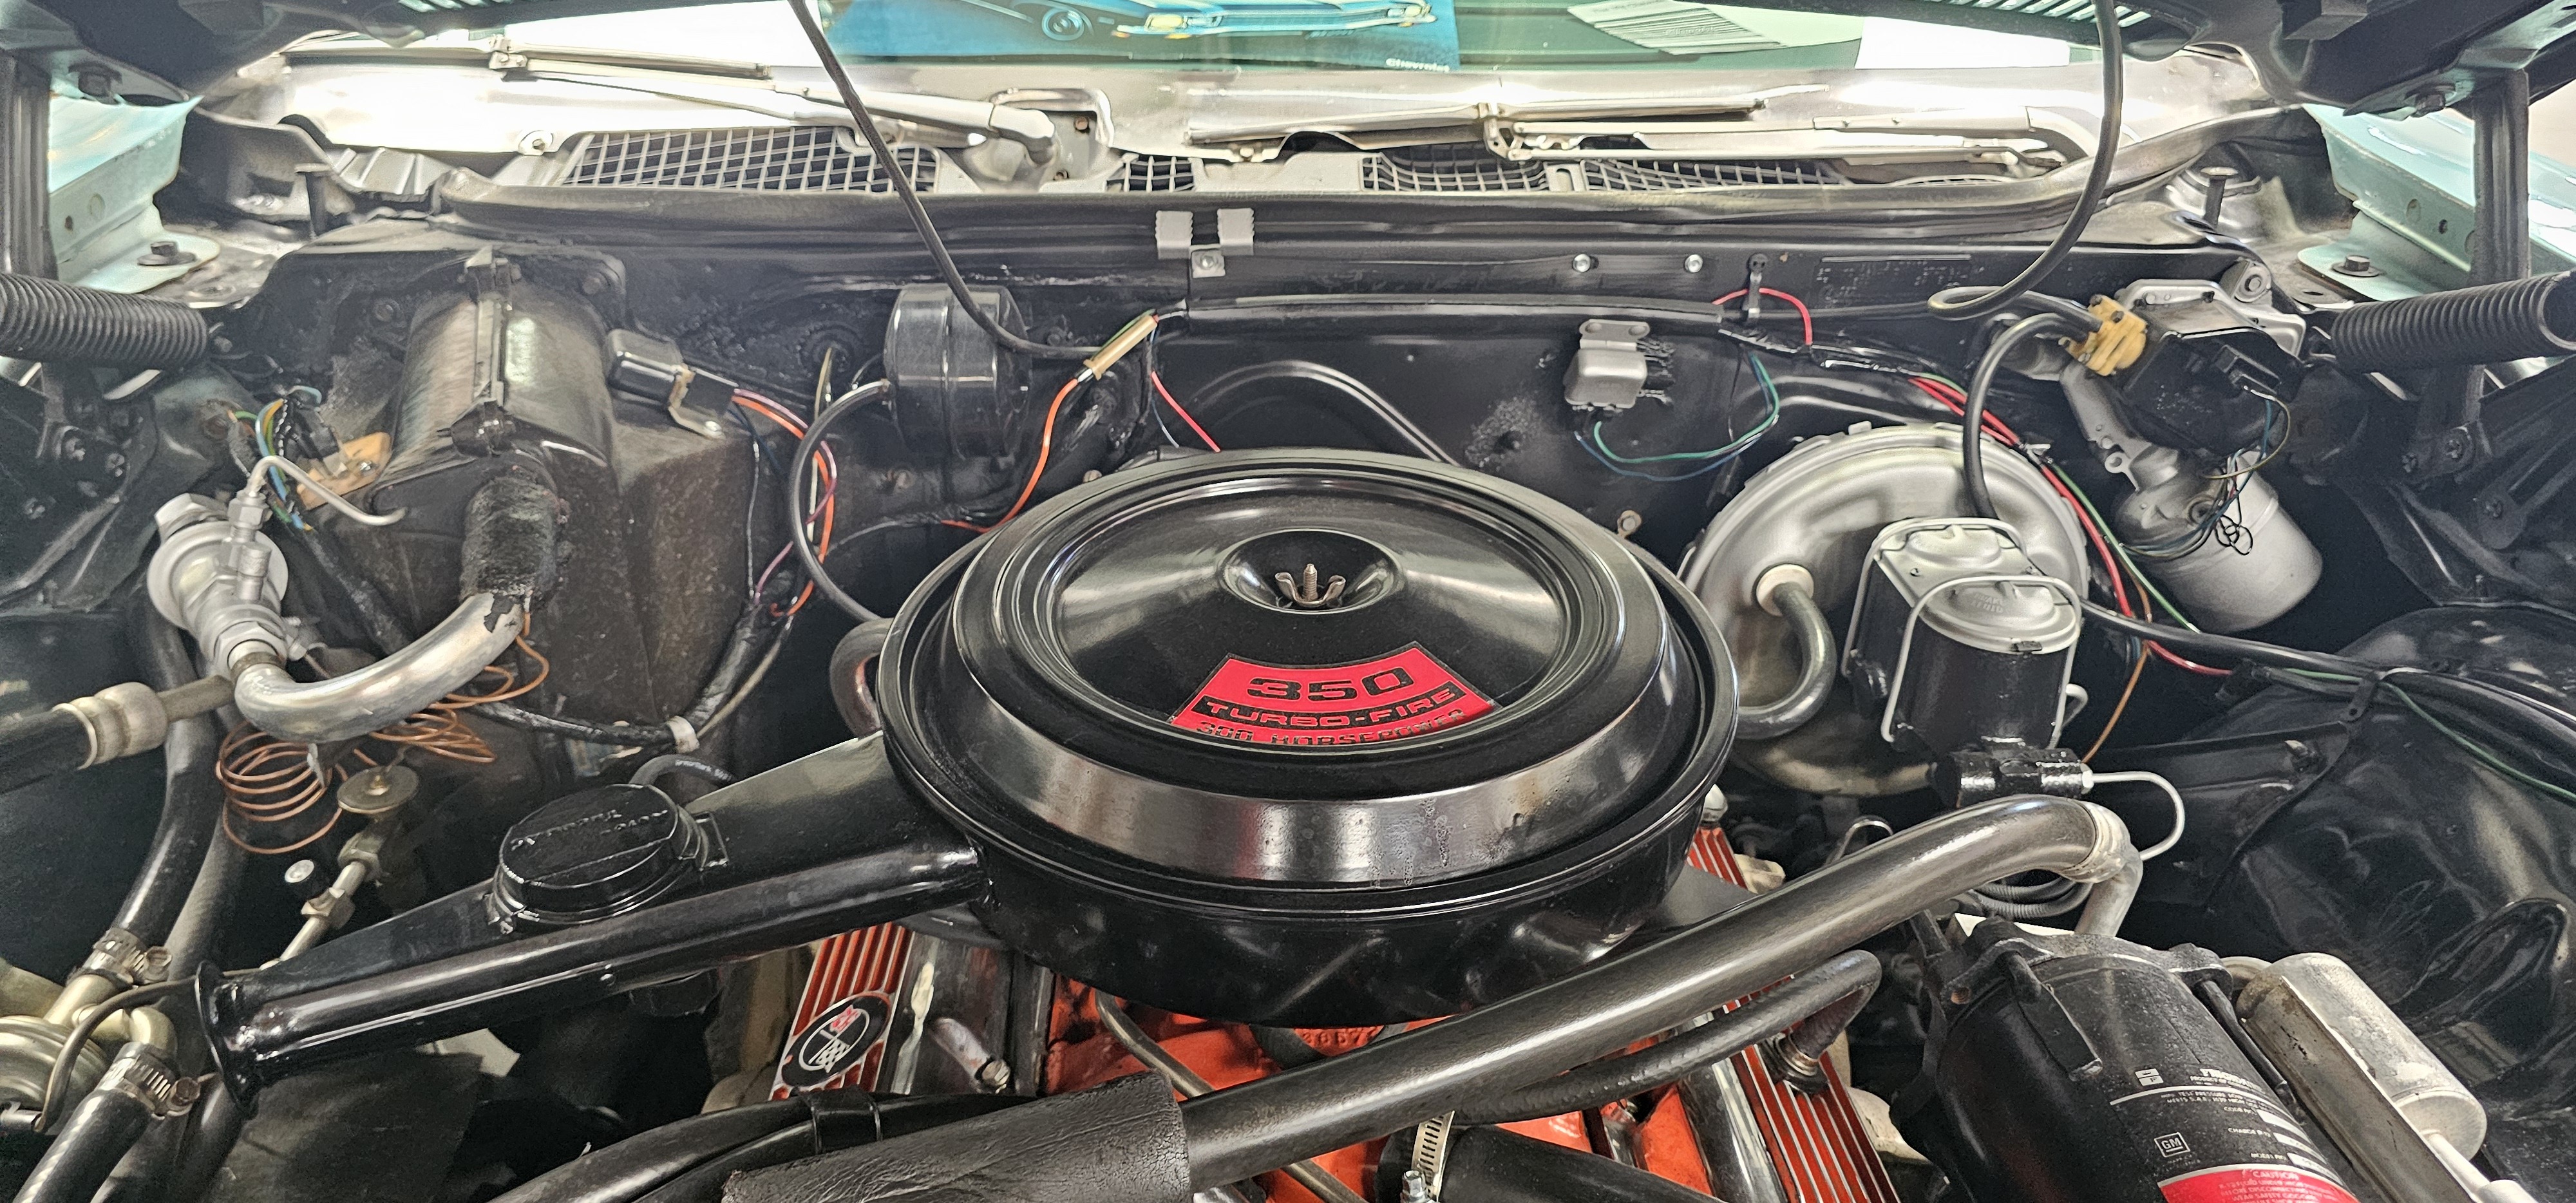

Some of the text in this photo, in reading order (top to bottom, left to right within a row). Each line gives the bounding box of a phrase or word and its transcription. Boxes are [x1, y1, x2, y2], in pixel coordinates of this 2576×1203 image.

[1247, 667, 1415, 702] 350
[1206, 687, 1456, 728] TURBO-FIRE
[2161, 1137, 2182, 1150] GM
